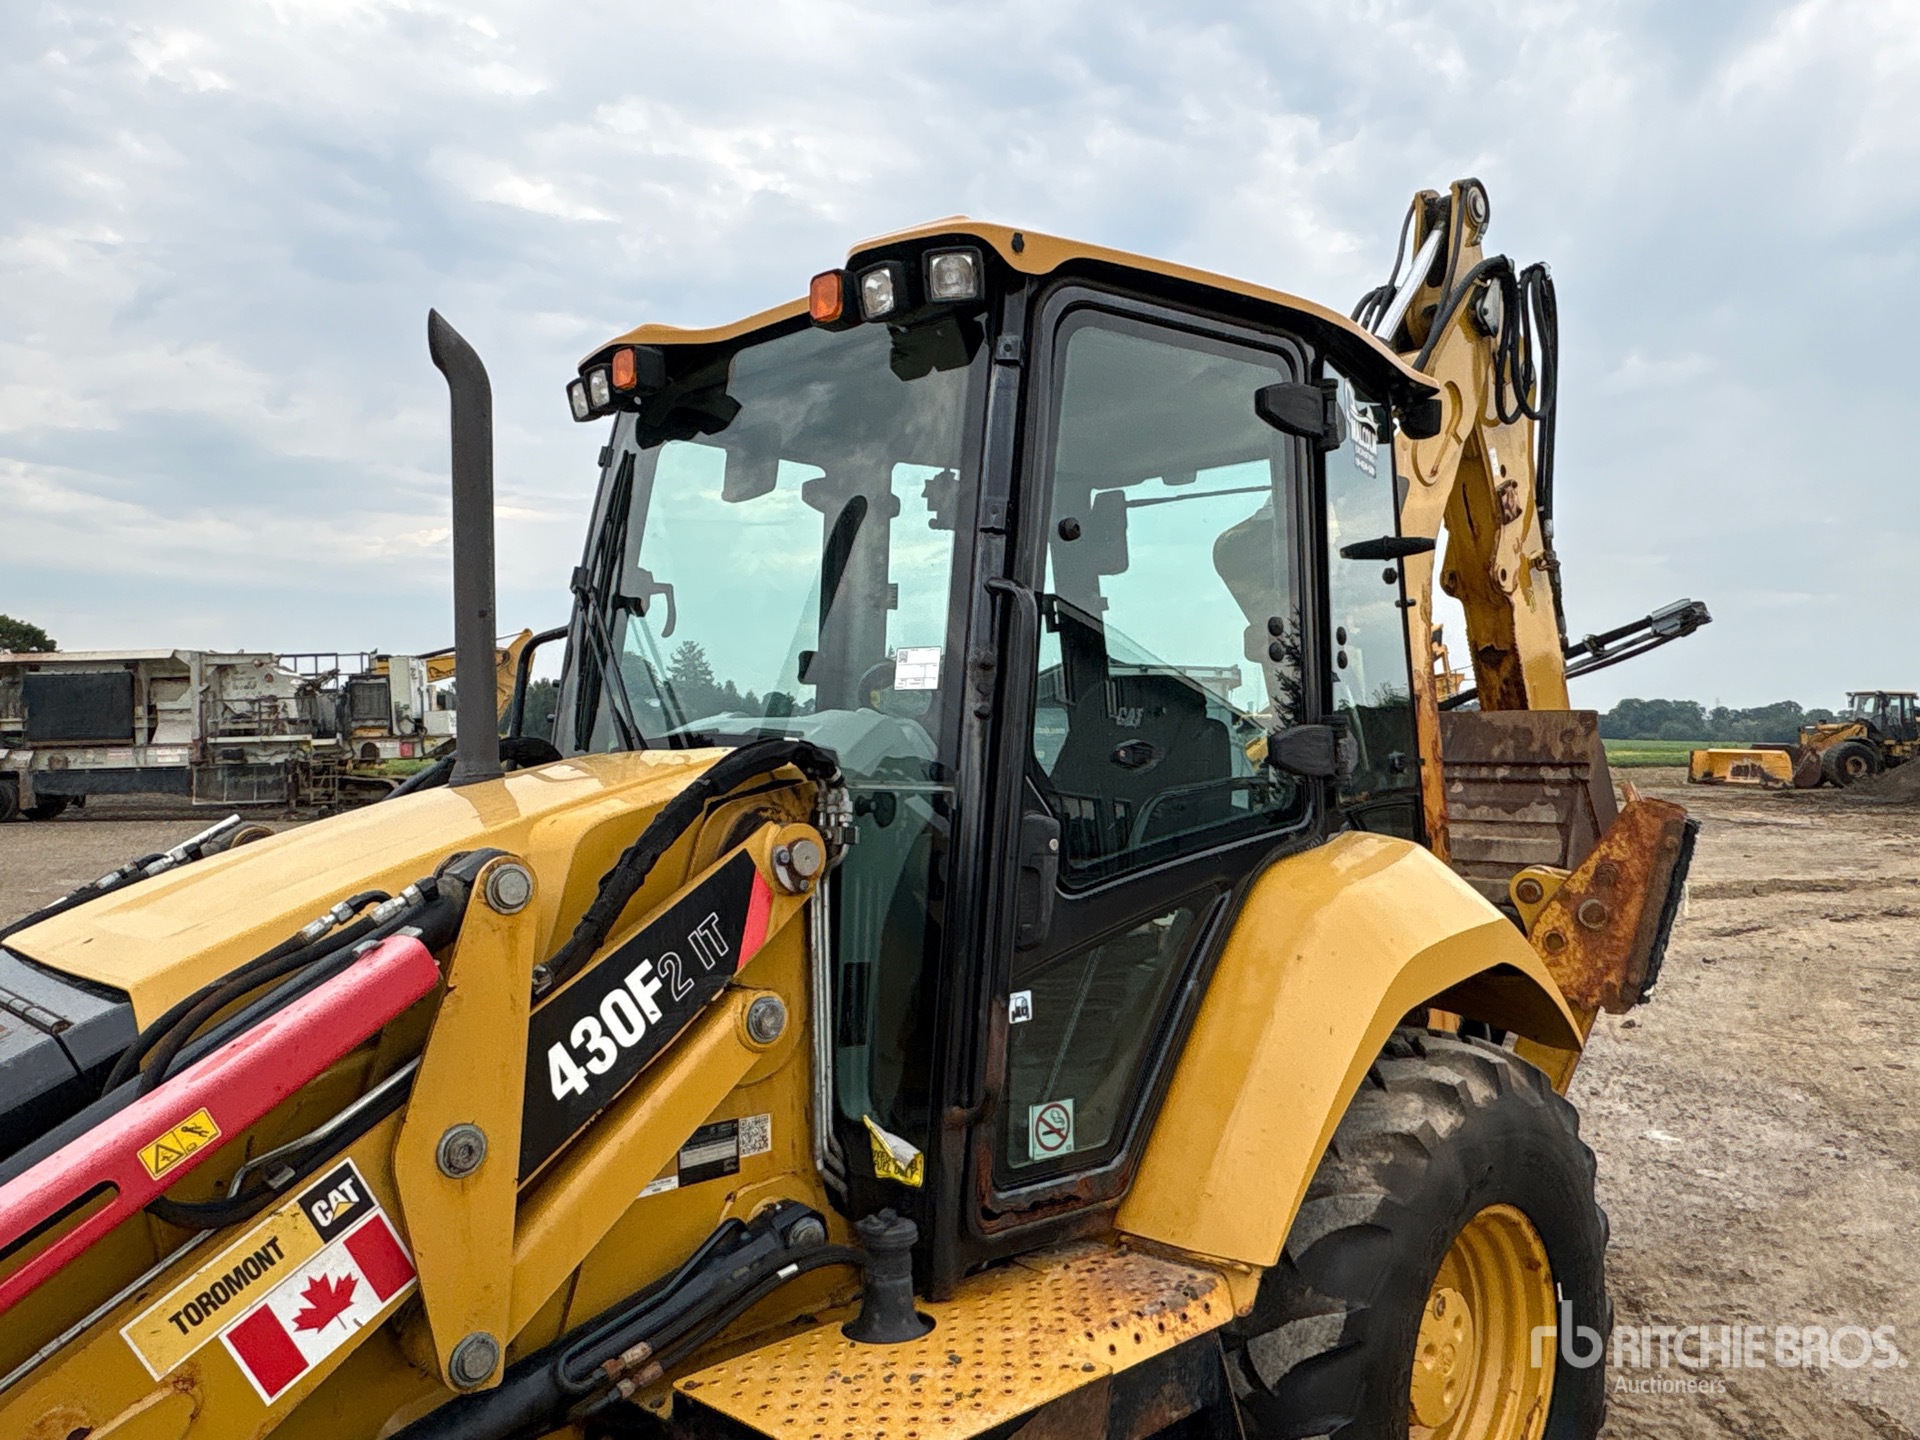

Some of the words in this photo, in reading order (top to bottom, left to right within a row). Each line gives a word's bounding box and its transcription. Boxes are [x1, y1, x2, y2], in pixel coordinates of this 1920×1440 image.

[688, 911, 730, 971] IT
[311, 1177, 360, 1227] CAT
[168, 1236, 285, 1335] TOROMONT
